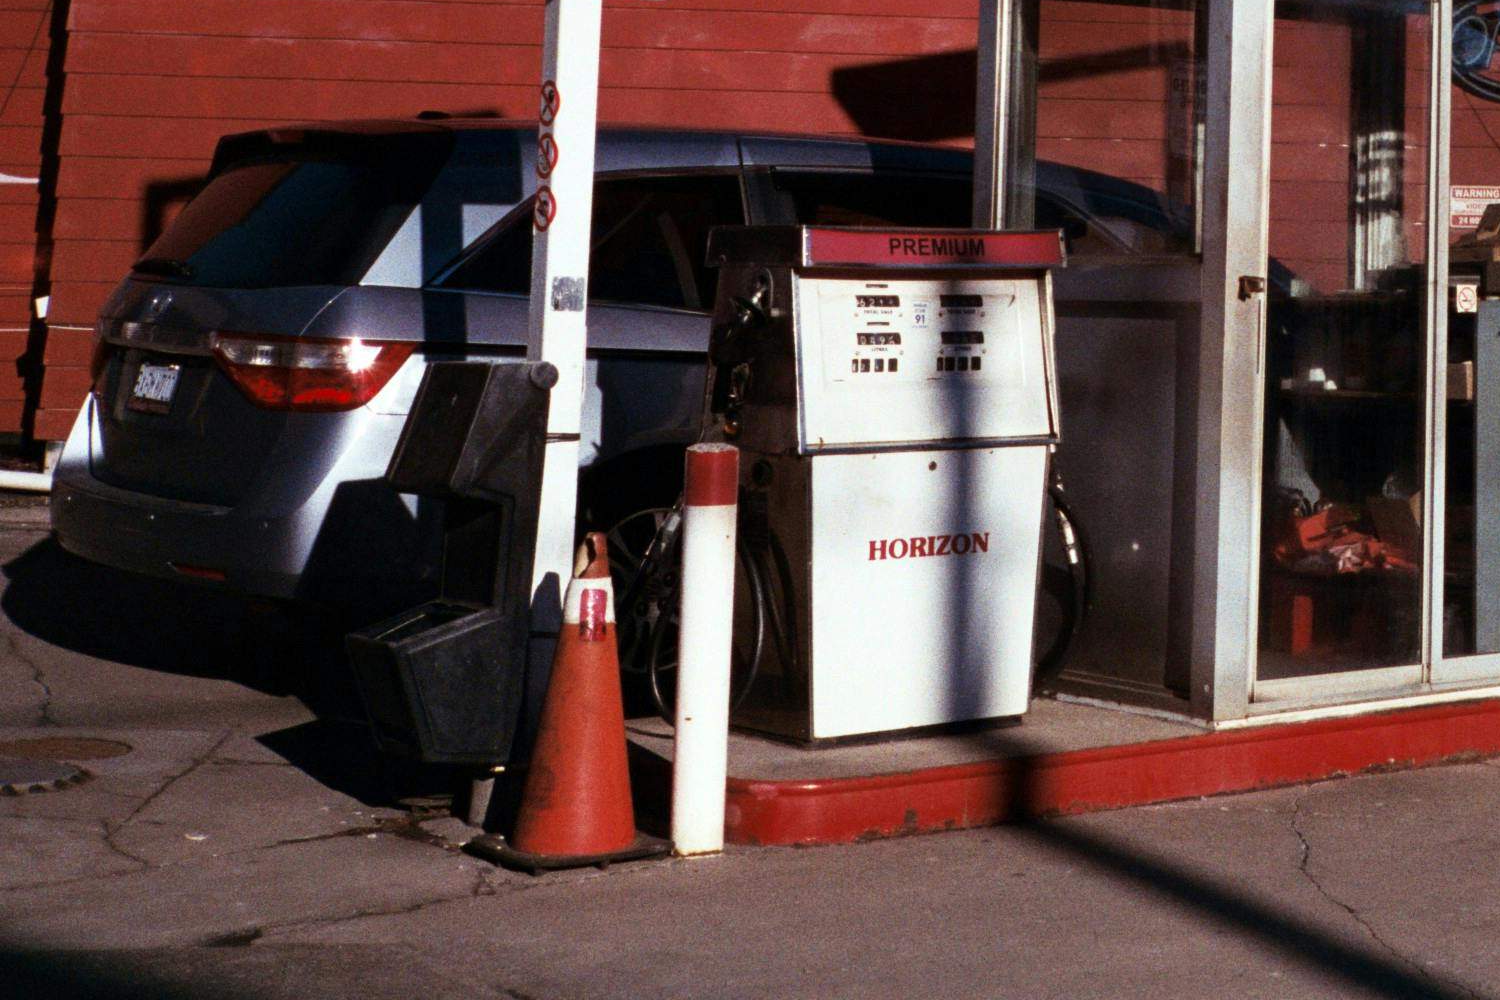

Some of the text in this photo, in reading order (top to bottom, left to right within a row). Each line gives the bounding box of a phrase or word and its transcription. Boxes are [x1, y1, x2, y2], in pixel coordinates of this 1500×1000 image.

[1454, 188, 1500, 199] WARNING
[888, 237, 986, 257] PREMIUM
[914, 314, 926, 325] 91
[868, 532, 990, 561] HORIZON
